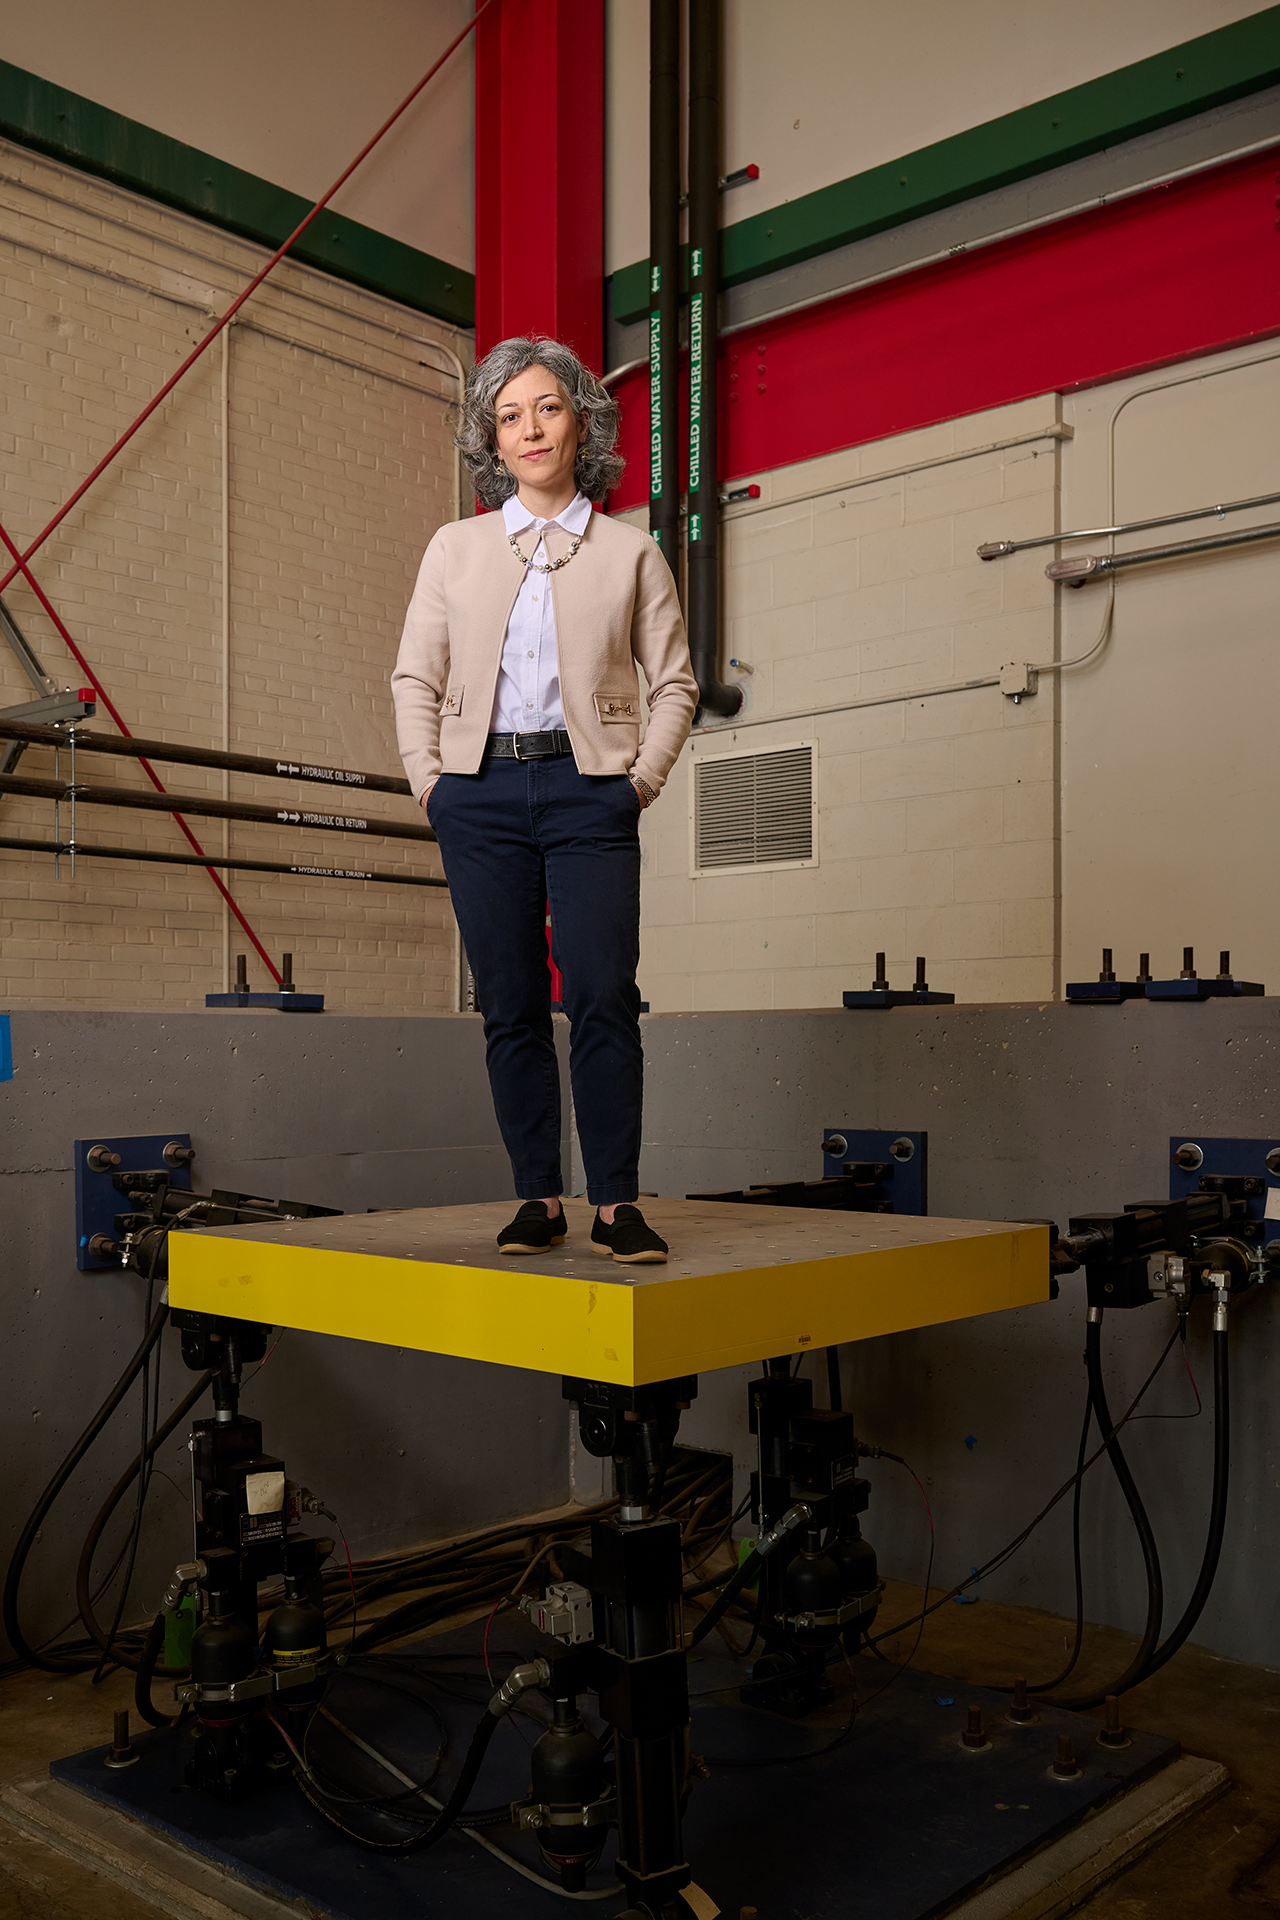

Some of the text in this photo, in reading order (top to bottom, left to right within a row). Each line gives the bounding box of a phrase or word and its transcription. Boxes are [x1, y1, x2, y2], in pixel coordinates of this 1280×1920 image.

[690, 299, 702, 487] CHILLED WATER RETURN
[651, 317, 662, 494] CHILLED WATER SUPPLY
[301, 766, 366, 784] HYDRAULIC OIL SUPPLY
[302, 813, 367, 829] HYDRAULIC OIL RETURN
[298, 866, 365, 878] HYDRAULIC OIL DRAIN
